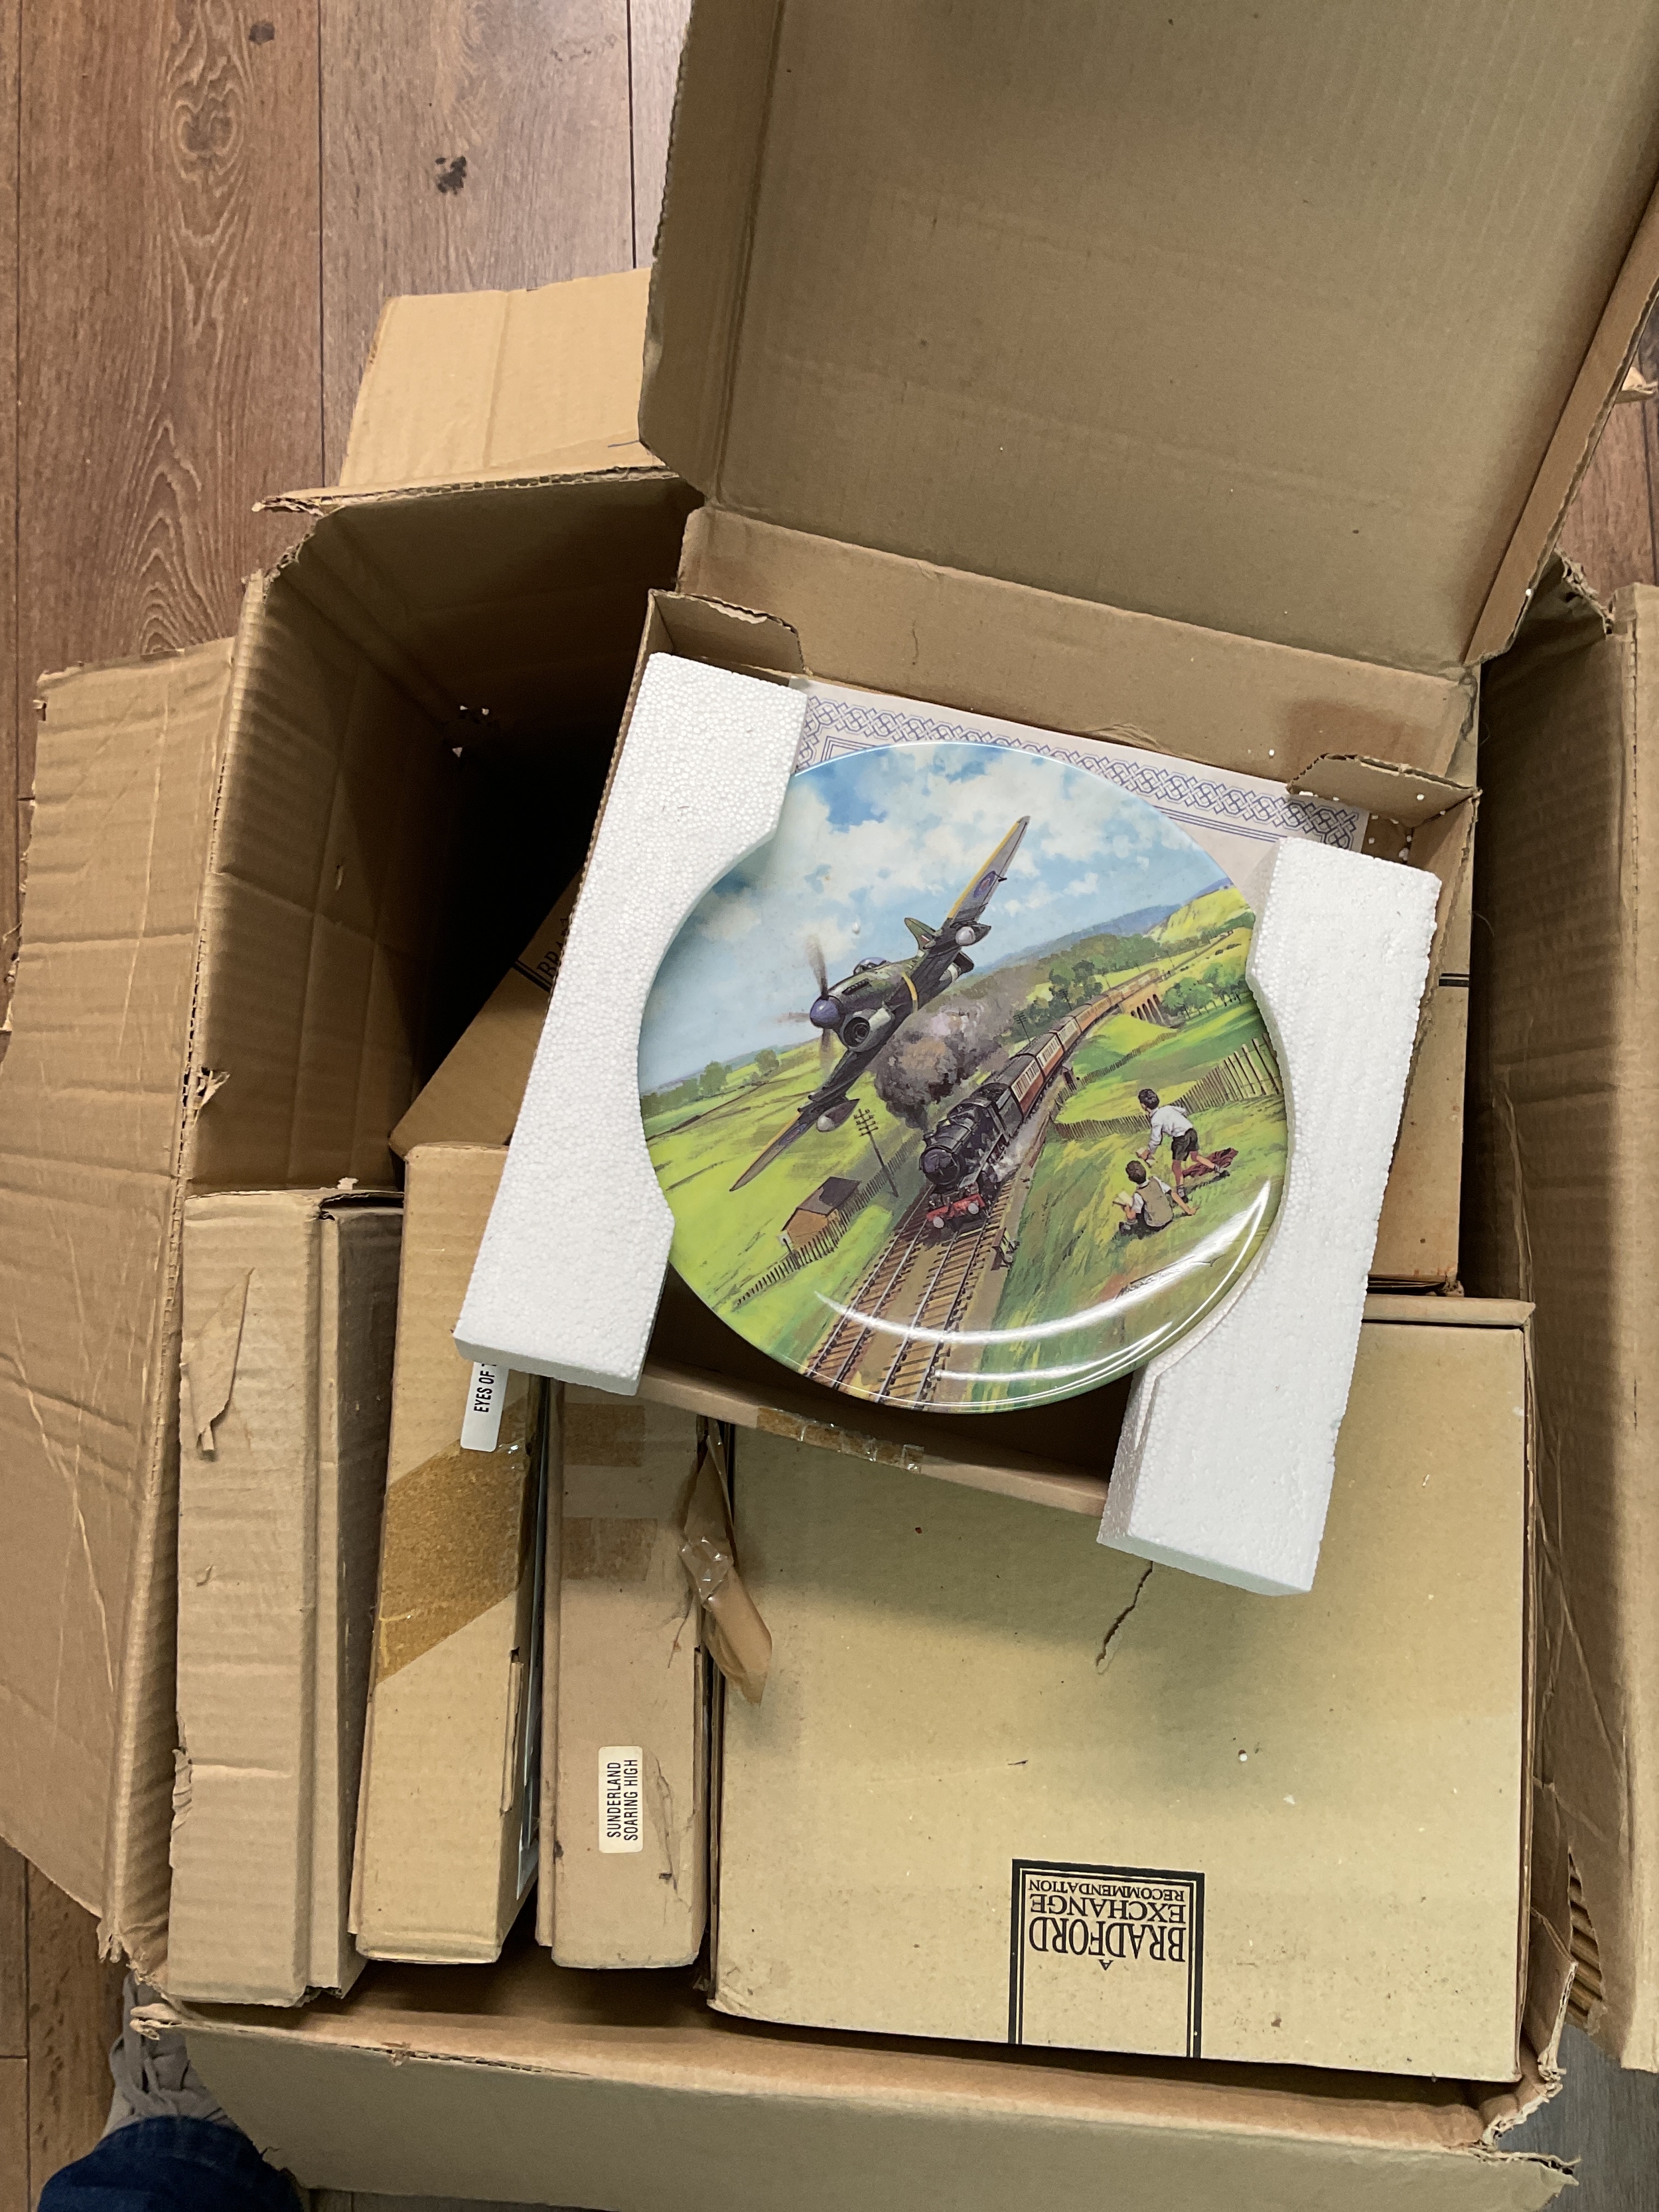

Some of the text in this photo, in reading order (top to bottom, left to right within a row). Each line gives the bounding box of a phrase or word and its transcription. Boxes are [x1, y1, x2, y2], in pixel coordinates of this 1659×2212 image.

[478, 1370, 495, 1384] OF
[474, 1387, 492, 1412] EYES
[607, 1762, 621, 1837] SUNDERLAND
[624, 1759, 638, 1840] SOARING HIGH
[1029, 1880, 1185, 1901] RECOMMENDATION
[1030, 1894, 1186, 1924] EXCHANGE
[1029, 1917, 1187, 1962] BRADFORD
[1099, 1959, 1114, 1971] A
